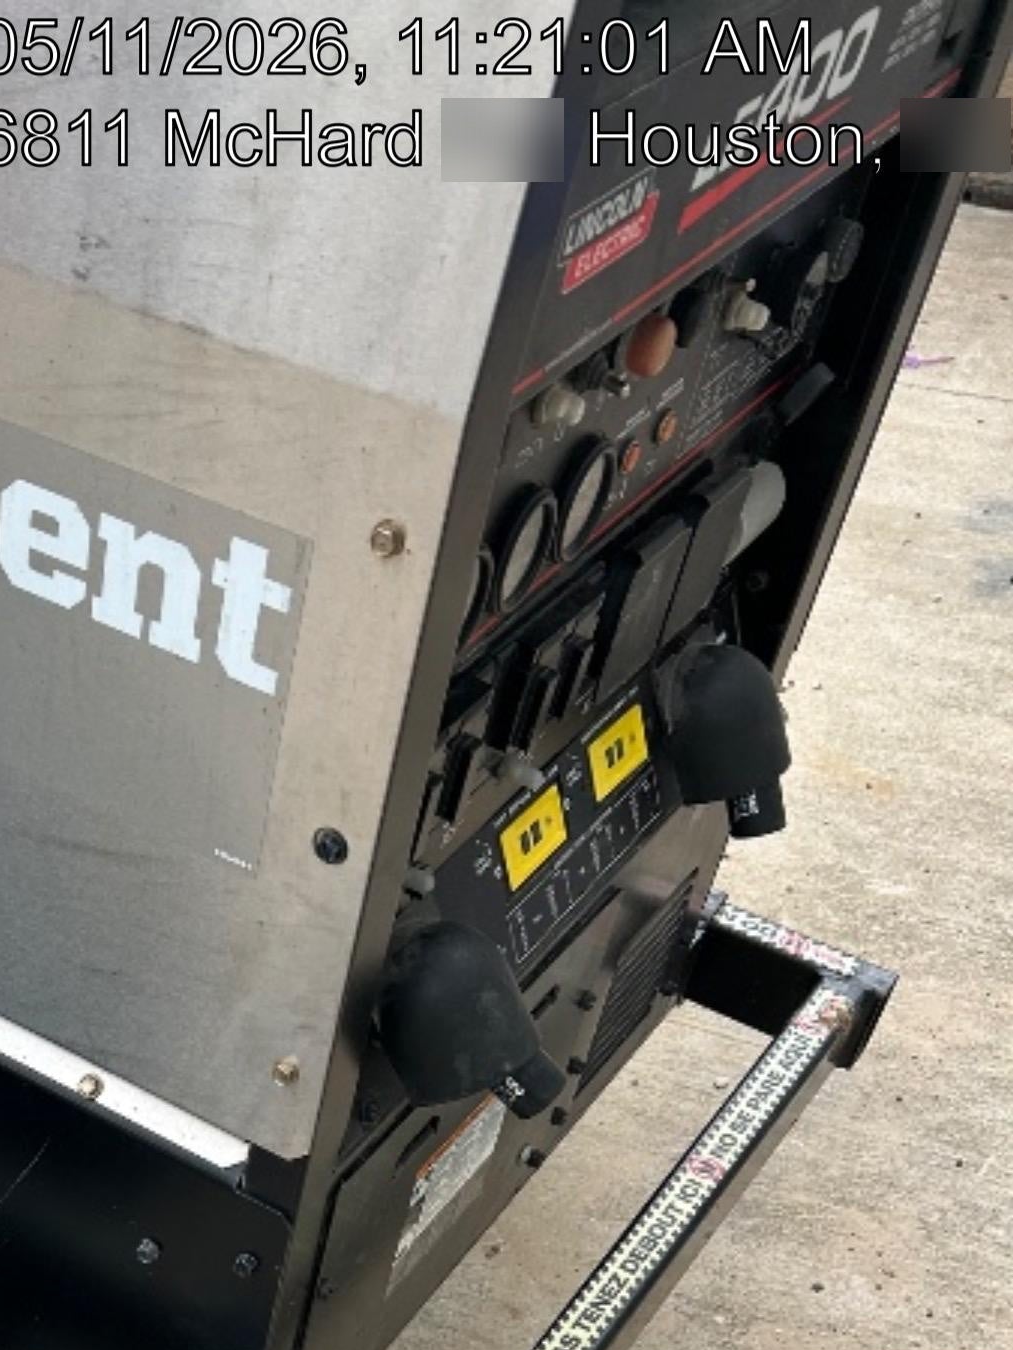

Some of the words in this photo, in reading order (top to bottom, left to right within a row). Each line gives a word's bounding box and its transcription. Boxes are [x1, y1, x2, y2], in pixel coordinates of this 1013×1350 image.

[571, 1274, 630, 1332] TENEZ
[620, 1206, 685, 1275] DEBOUT
[675, 1178, 704, 1205] ICI
[709, 1132, 738, 1159] NO
[747, 1070, 786, 1113] PARE
